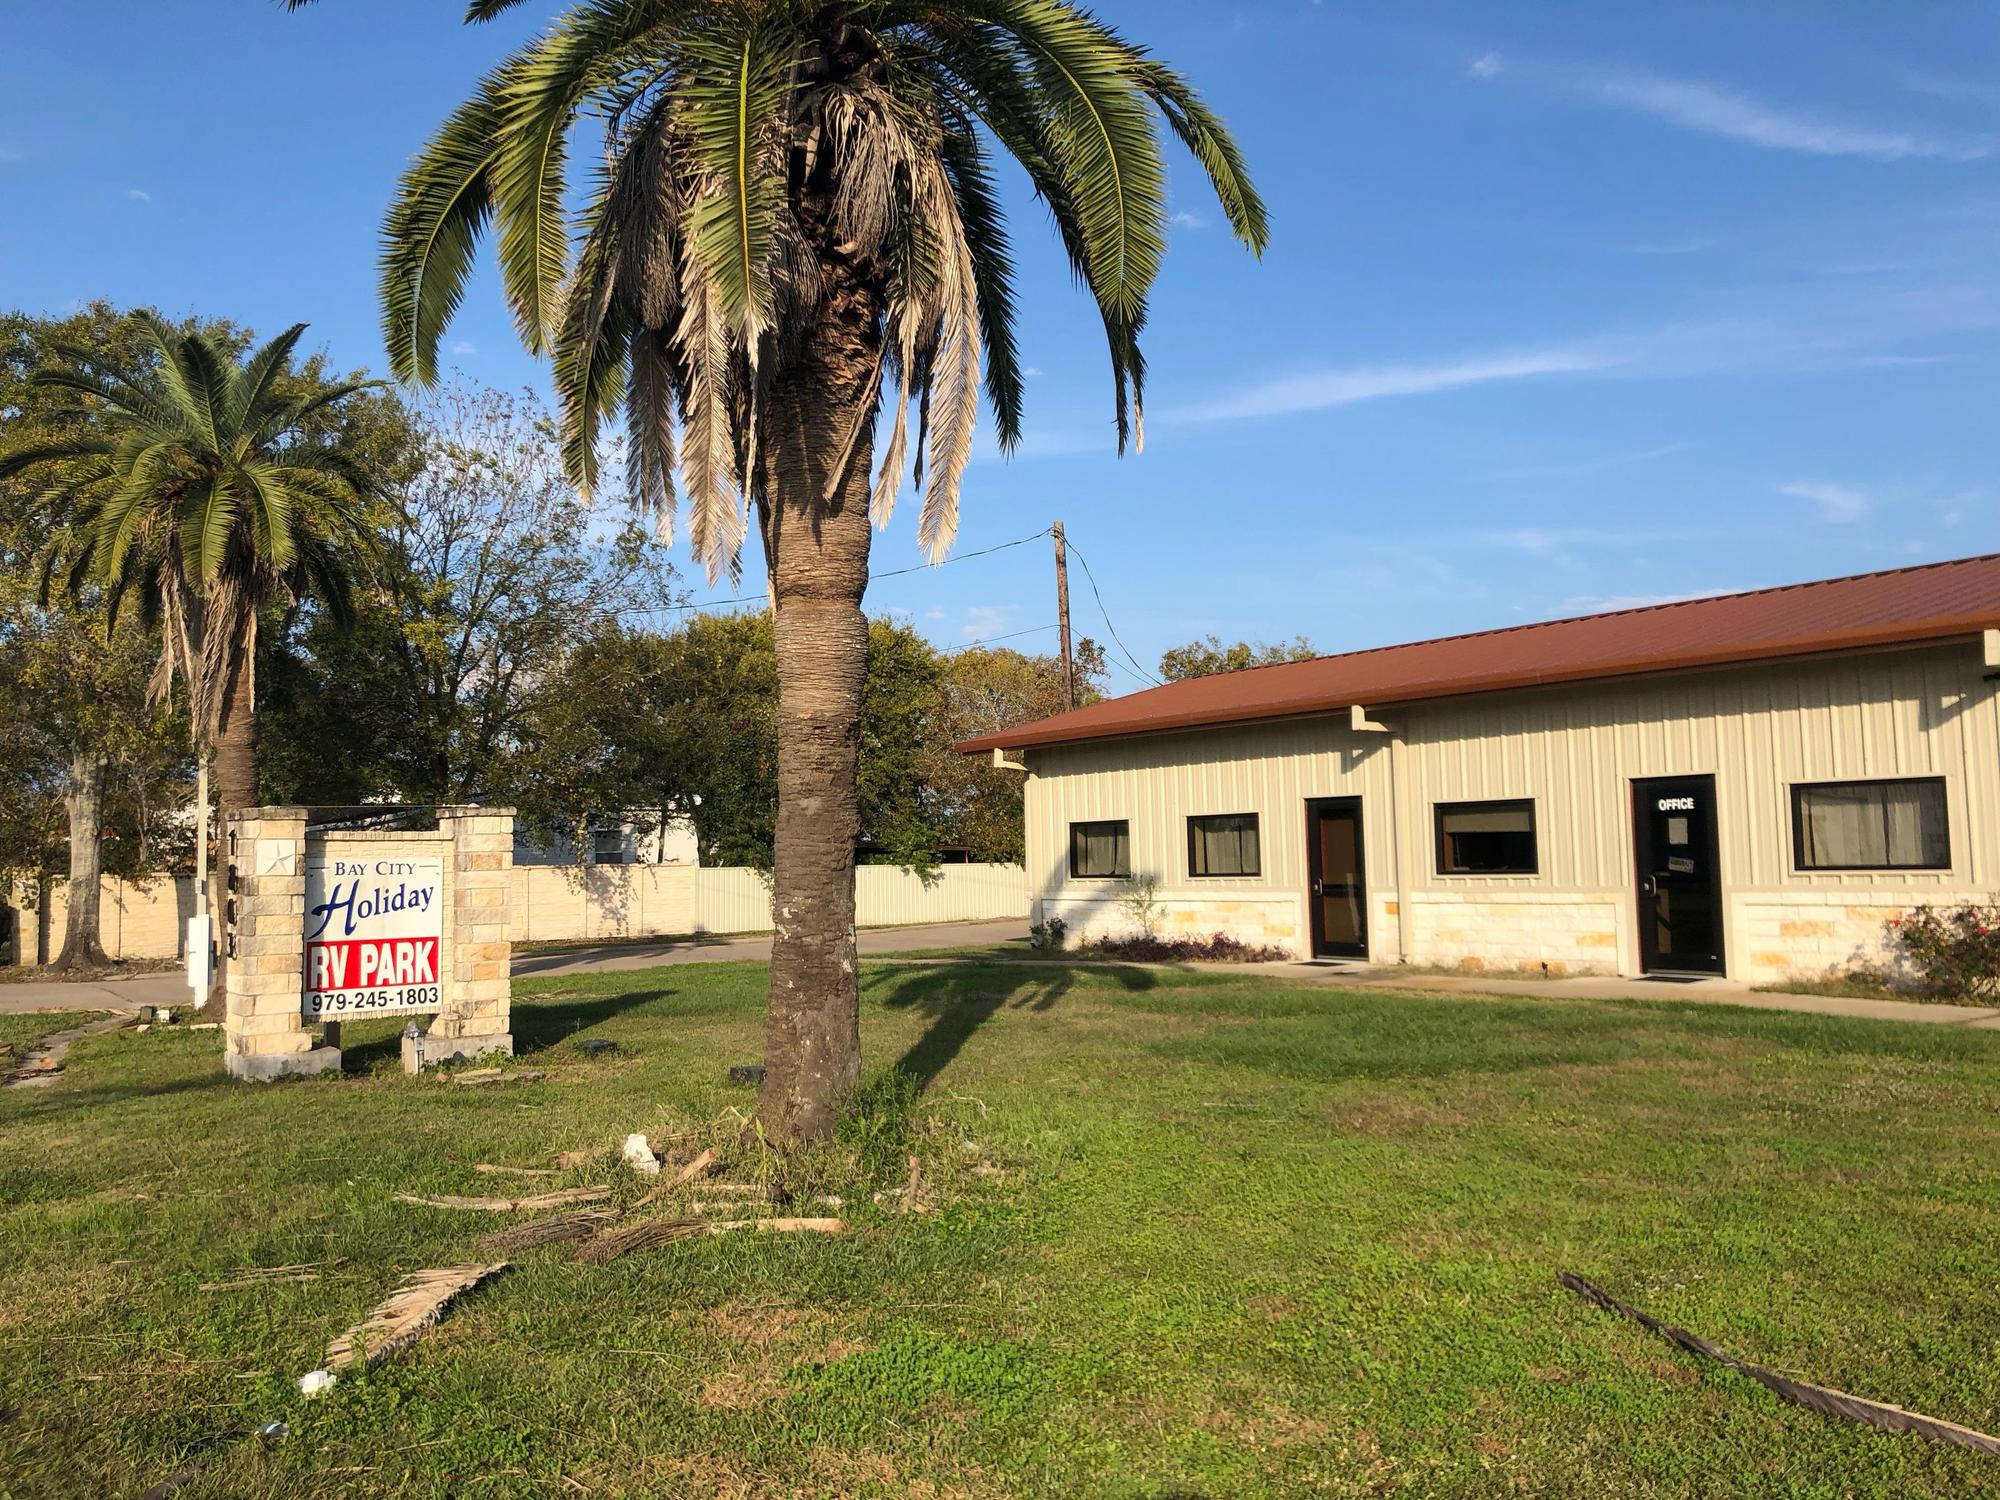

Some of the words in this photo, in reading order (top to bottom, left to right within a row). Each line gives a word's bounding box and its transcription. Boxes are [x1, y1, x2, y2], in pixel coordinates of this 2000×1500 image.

[1658, 797, 1695, 811] OFFICE
[335, 862, 367, 876] BAY
[375, 861, 416, 875] CITY
[309, 878, 434, 940] Holiday
[310, 944, 349, 989] RV
[360, 941, 435, 986] PARK
[312, 987, 438, 1012] 979-245-1803
